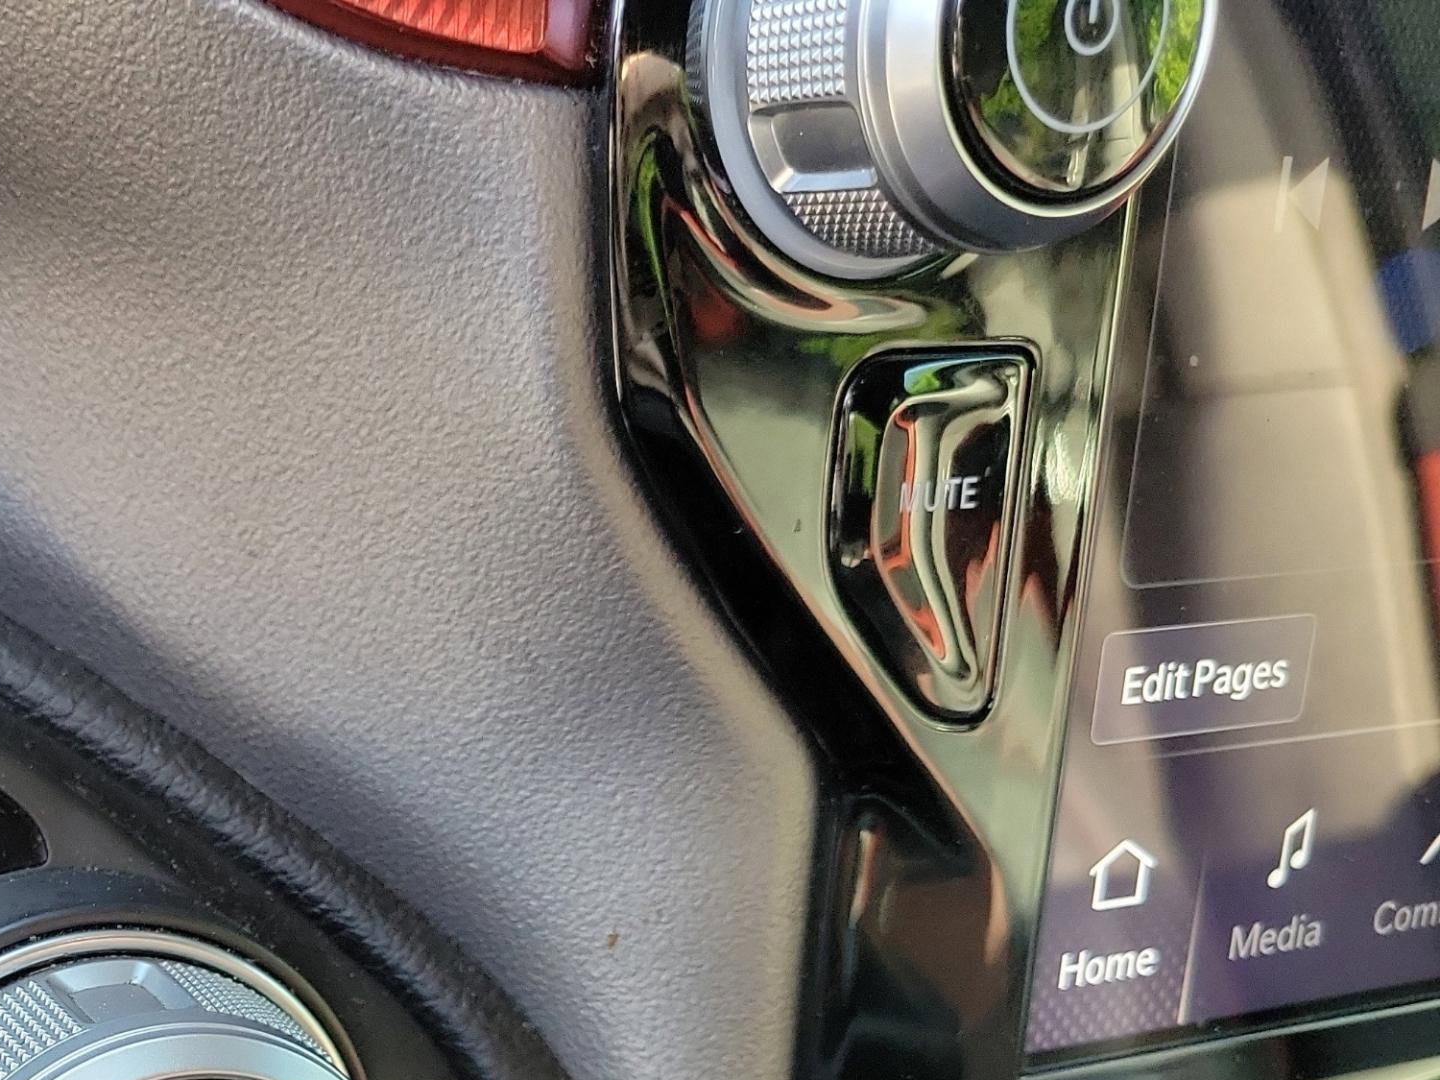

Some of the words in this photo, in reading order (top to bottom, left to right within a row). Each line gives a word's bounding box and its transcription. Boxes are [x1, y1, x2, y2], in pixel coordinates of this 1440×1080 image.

[899, 475, 981, 514] MUTE
[1121, 662, 1191, 706] Edit
[1192, 657, 1290, 701] Pages
[1228, 914, 1322, 961] Media
[1374, 900, 1440, 935] Com
[1058, 945, 1160, 990] Home
